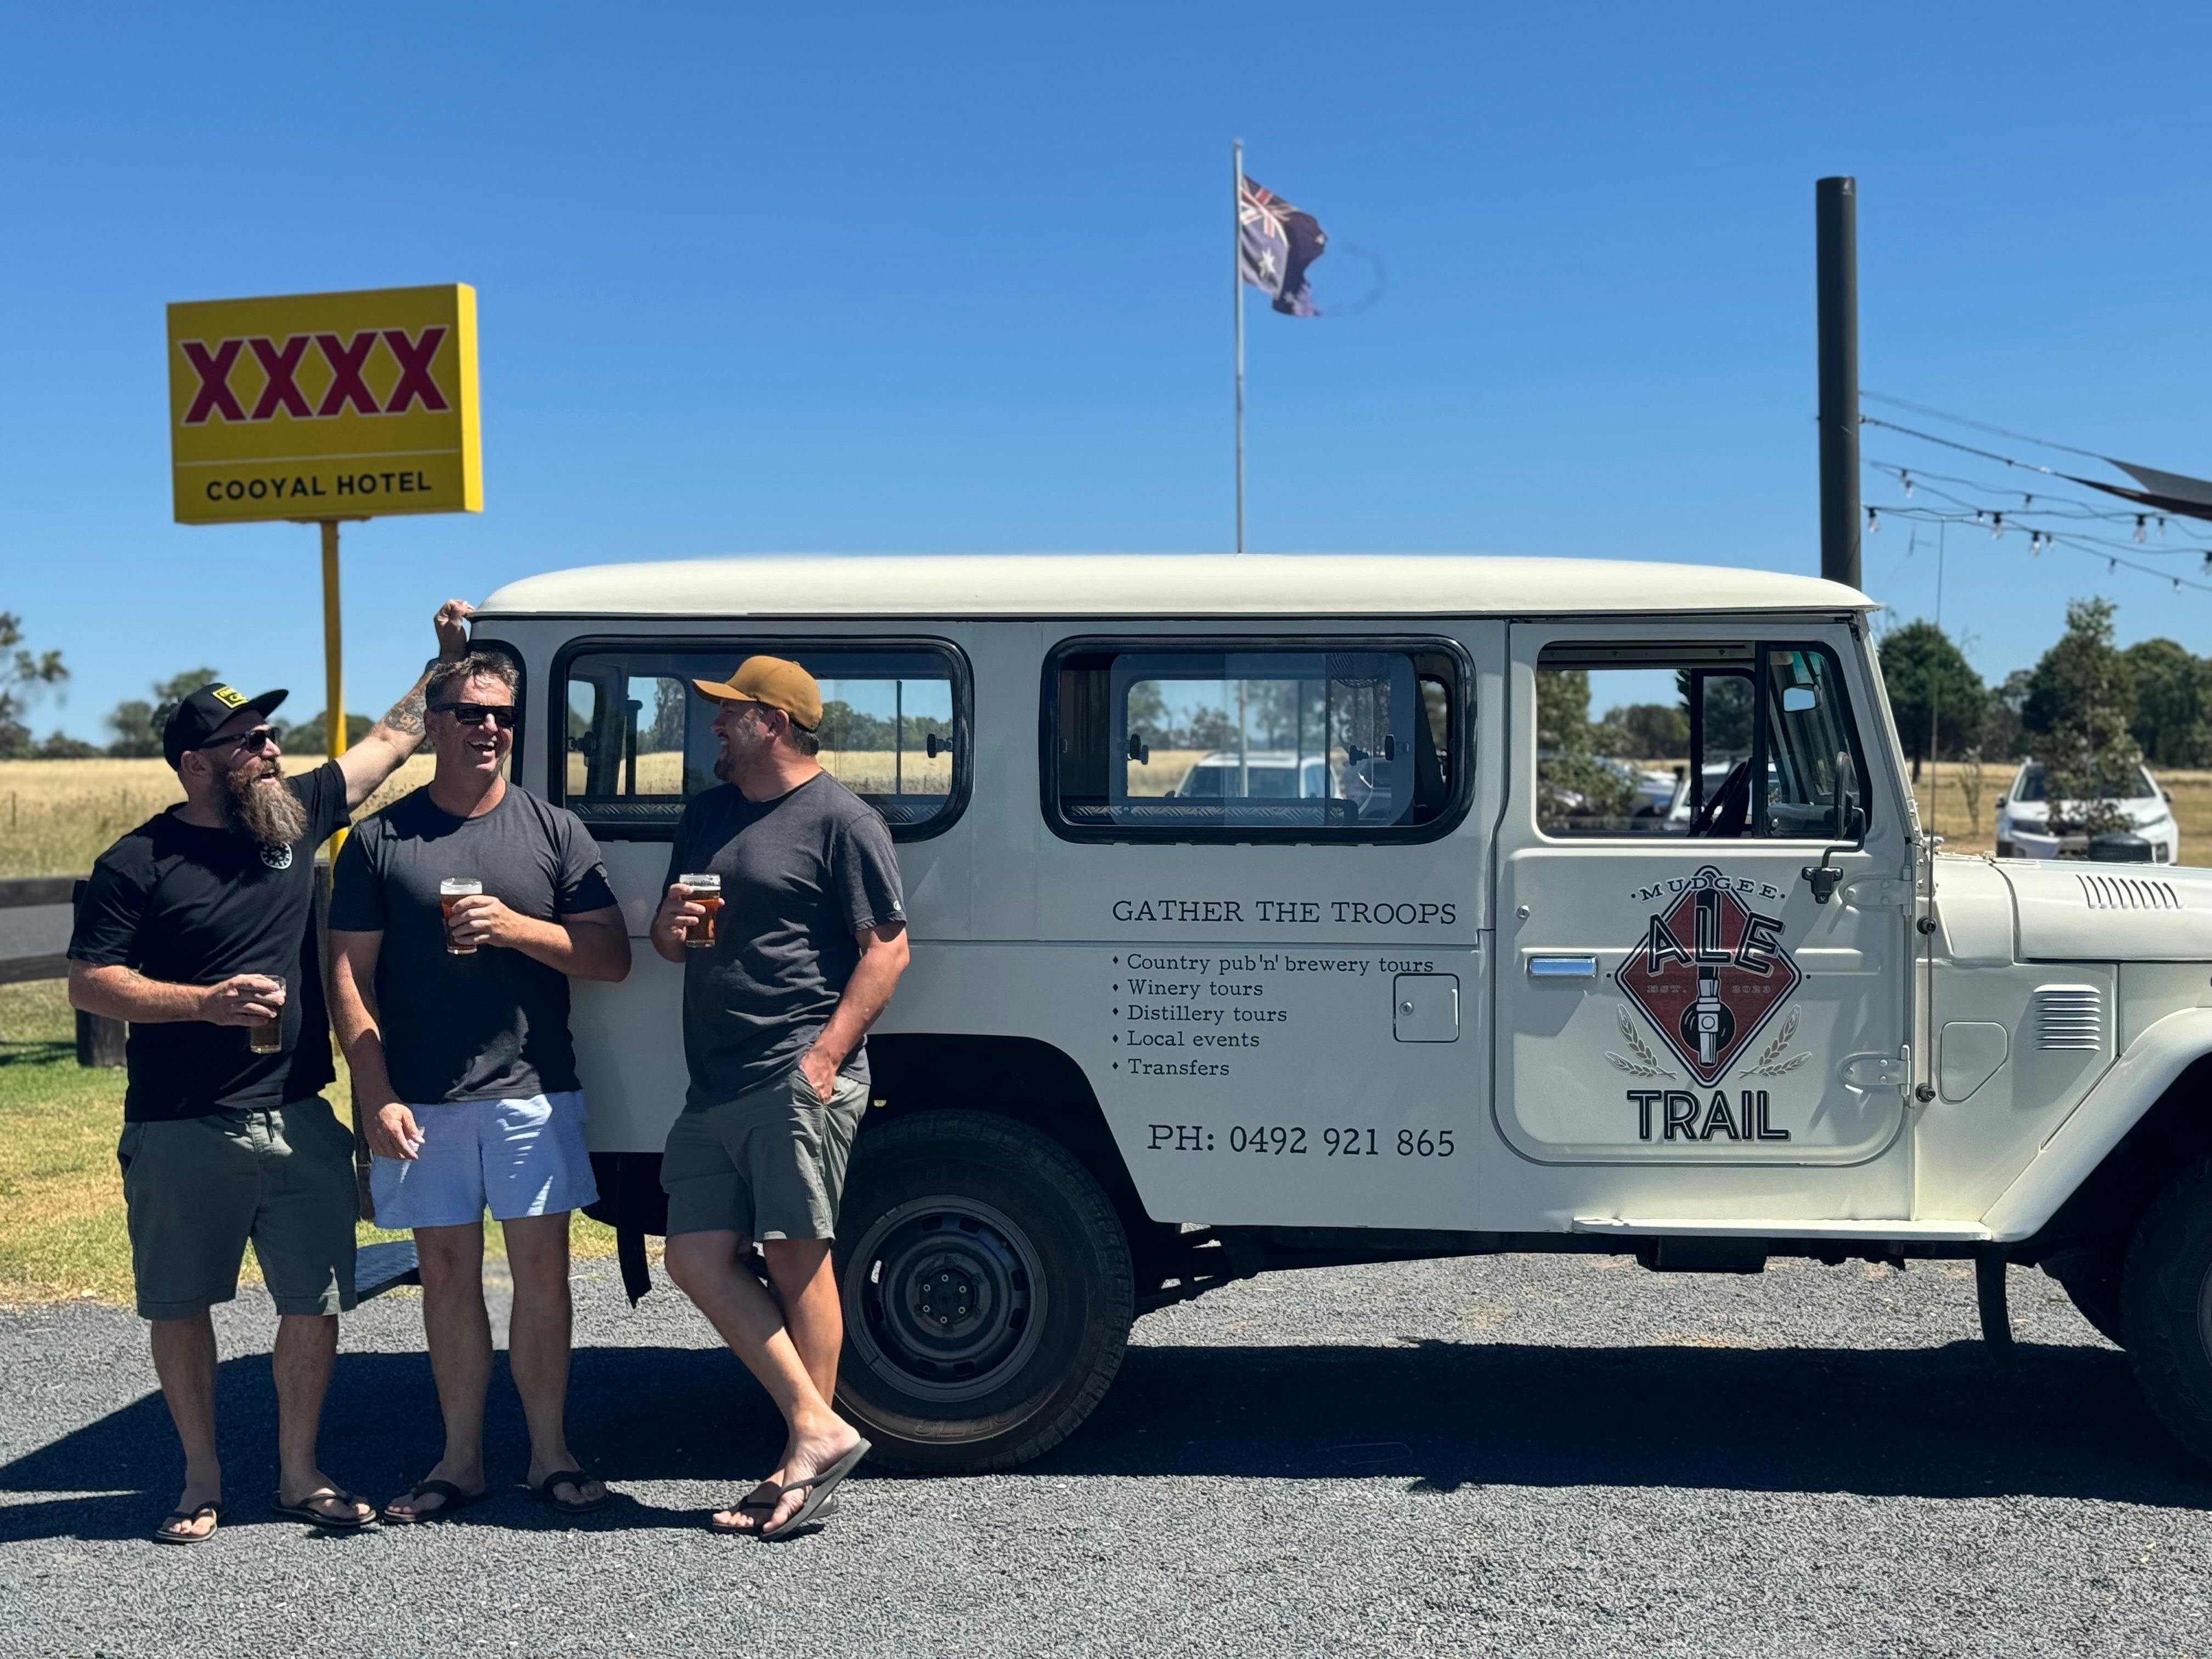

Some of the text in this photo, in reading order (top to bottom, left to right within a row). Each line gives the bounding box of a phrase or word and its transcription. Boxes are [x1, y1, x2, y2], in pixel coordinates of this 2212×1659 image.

[178, 325, 453, 426] XXXX
[206, 471, 431, 501] COOYAL HOTEL
[1640, 877, 1779, 902] MUDGEE
[1113, 900, 1456, 925] GATHER THE TROOPS
[1647, 911, 1786, 978] ALE
[1127, 954, 1211, 974] Country
[1284, 956, 1370, 976] brewery
[1379, 958, 1434, 973] tours
[1127, 979, 1263, 1000] Winery tours
[1127, 1005, 1287, 1025] Distillery tours
[1127, 1030, 1260, 1047] Local events
[1128, 1059, 1229, 1076] Transfers
[1627, 1090, 1792, 1141] TRAIL
[1147, 1124, 1455, 1157] PH: 0492 921 865
